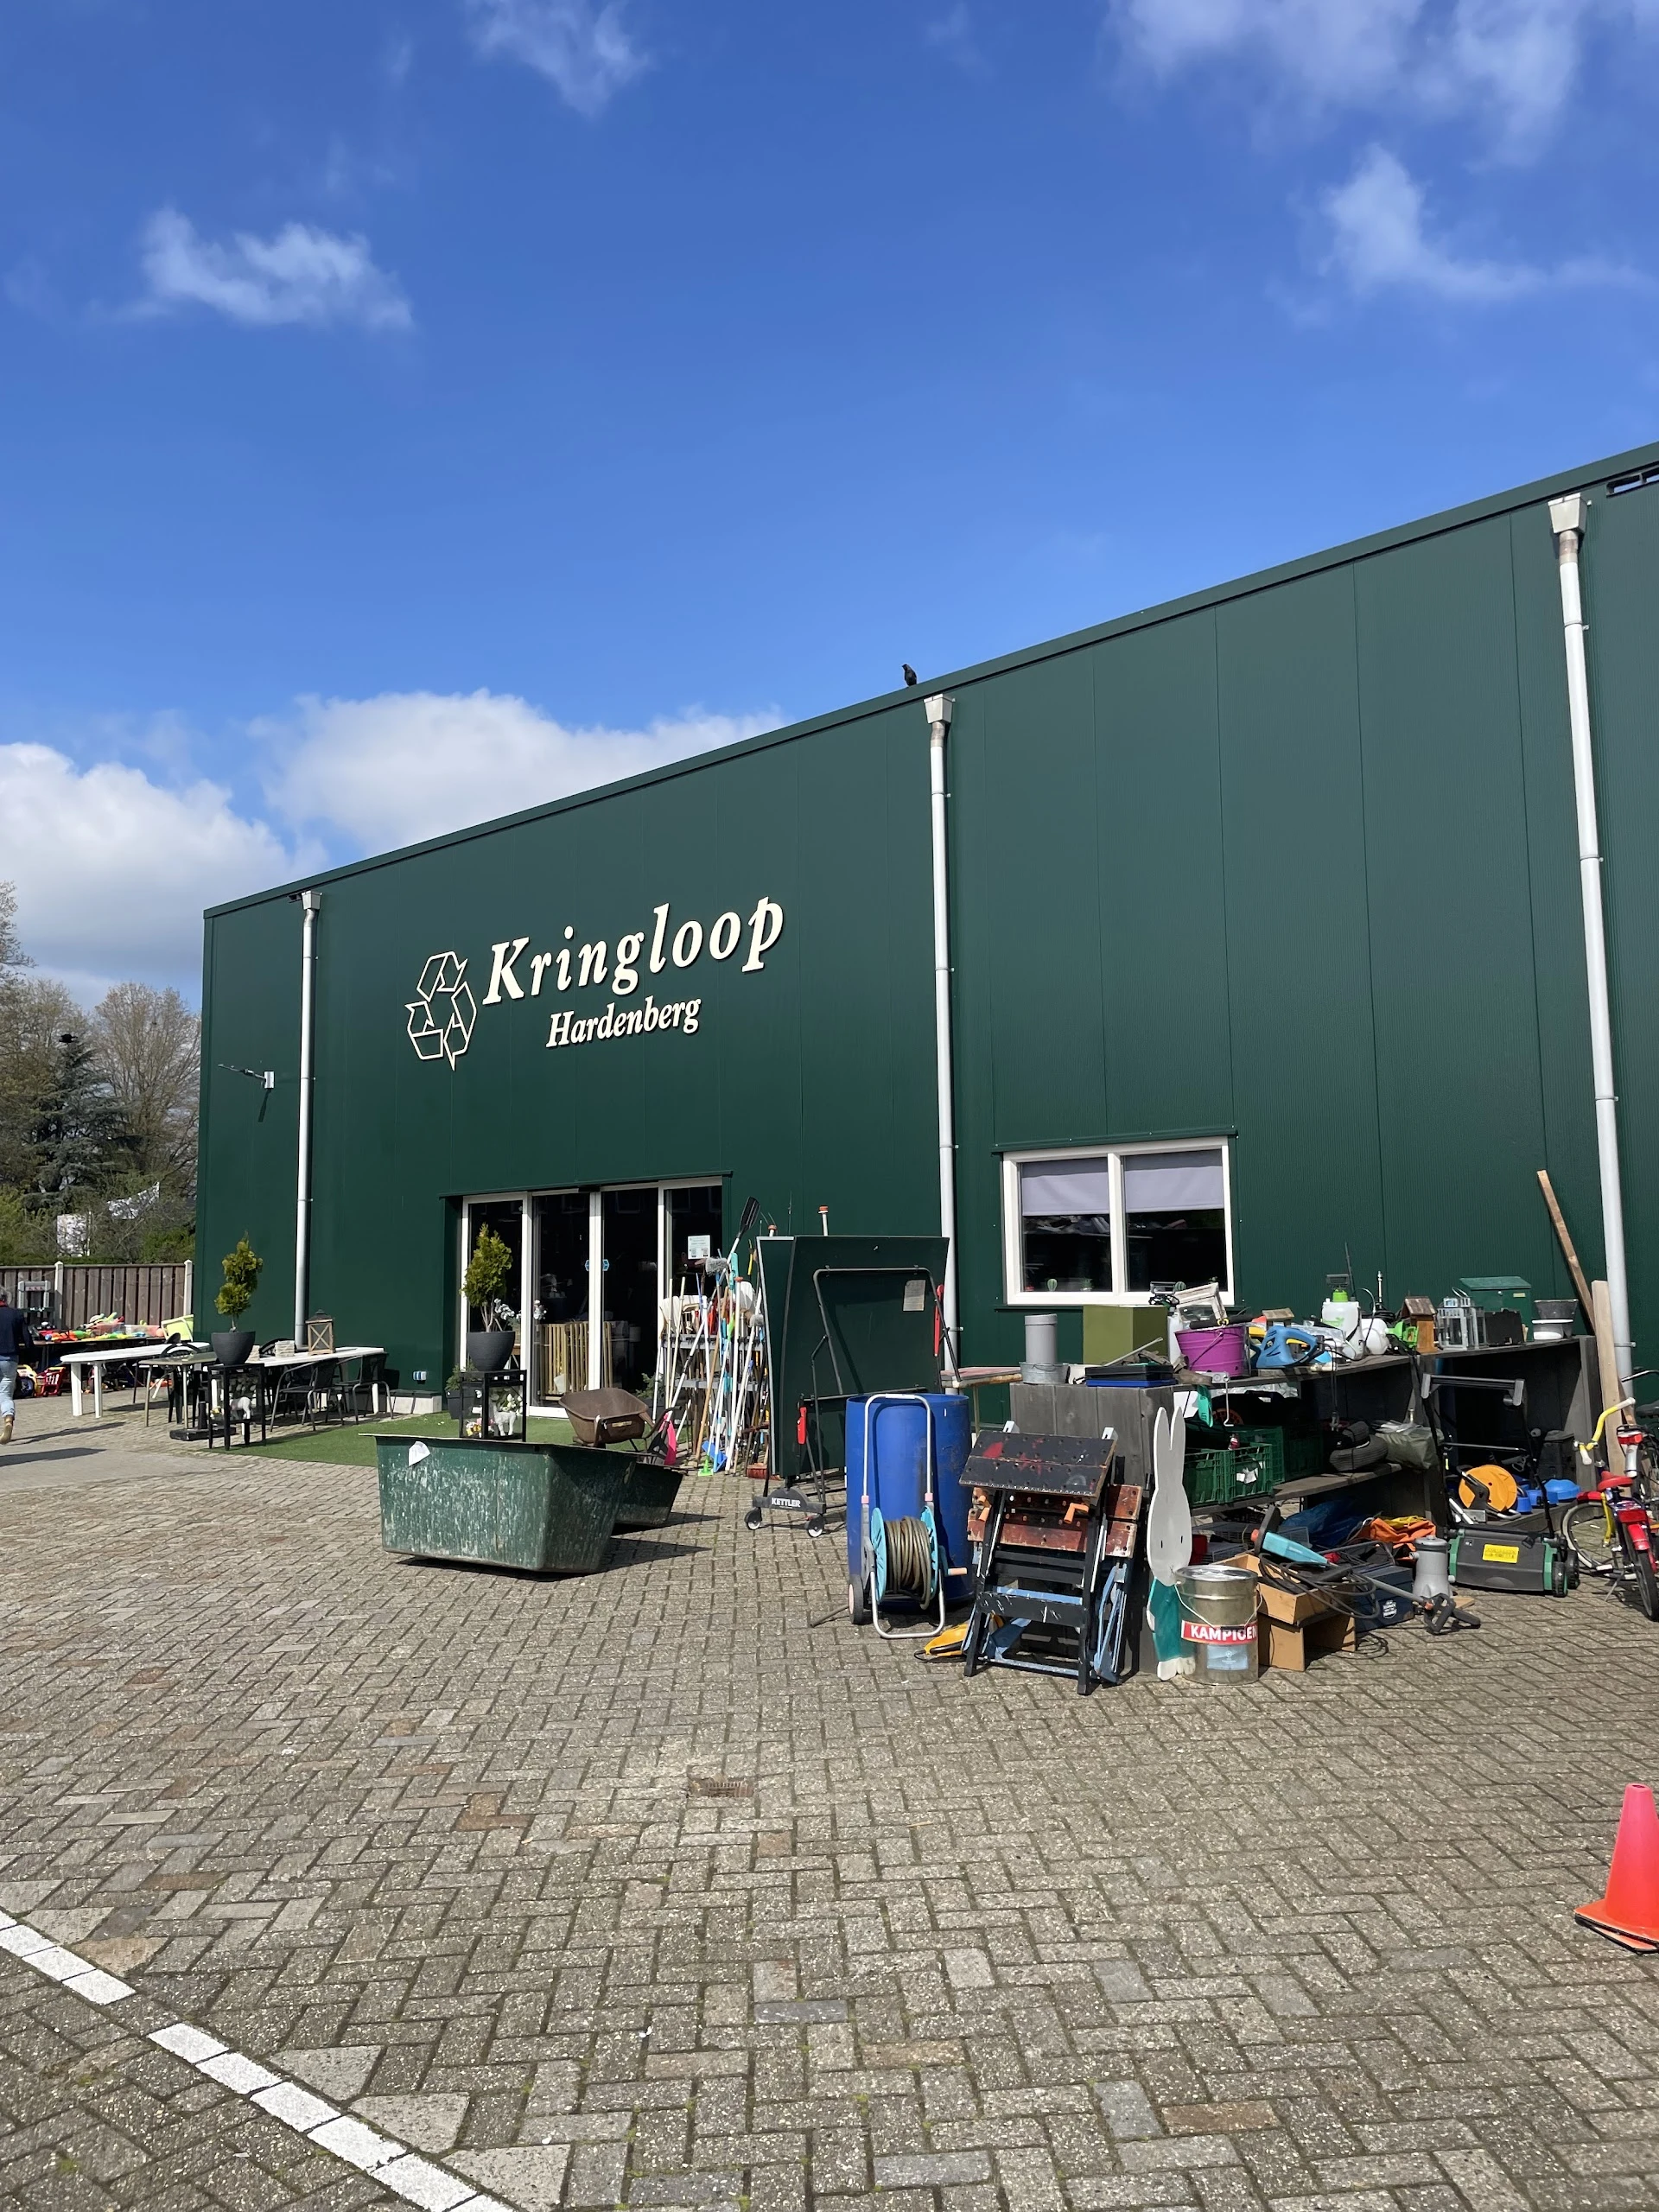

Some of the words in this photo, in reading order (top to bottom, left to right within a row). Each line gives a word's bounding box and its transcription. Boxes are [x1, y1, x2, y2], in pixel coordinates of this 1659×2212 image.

[482, 896, 784, 1005] Kringloop
[546, 995, 702, 1048] Hardenberg
[771, 1497, 801, 1508] KETTLER
[1191, 1624, 1257, 1641] KAMPIOEN
